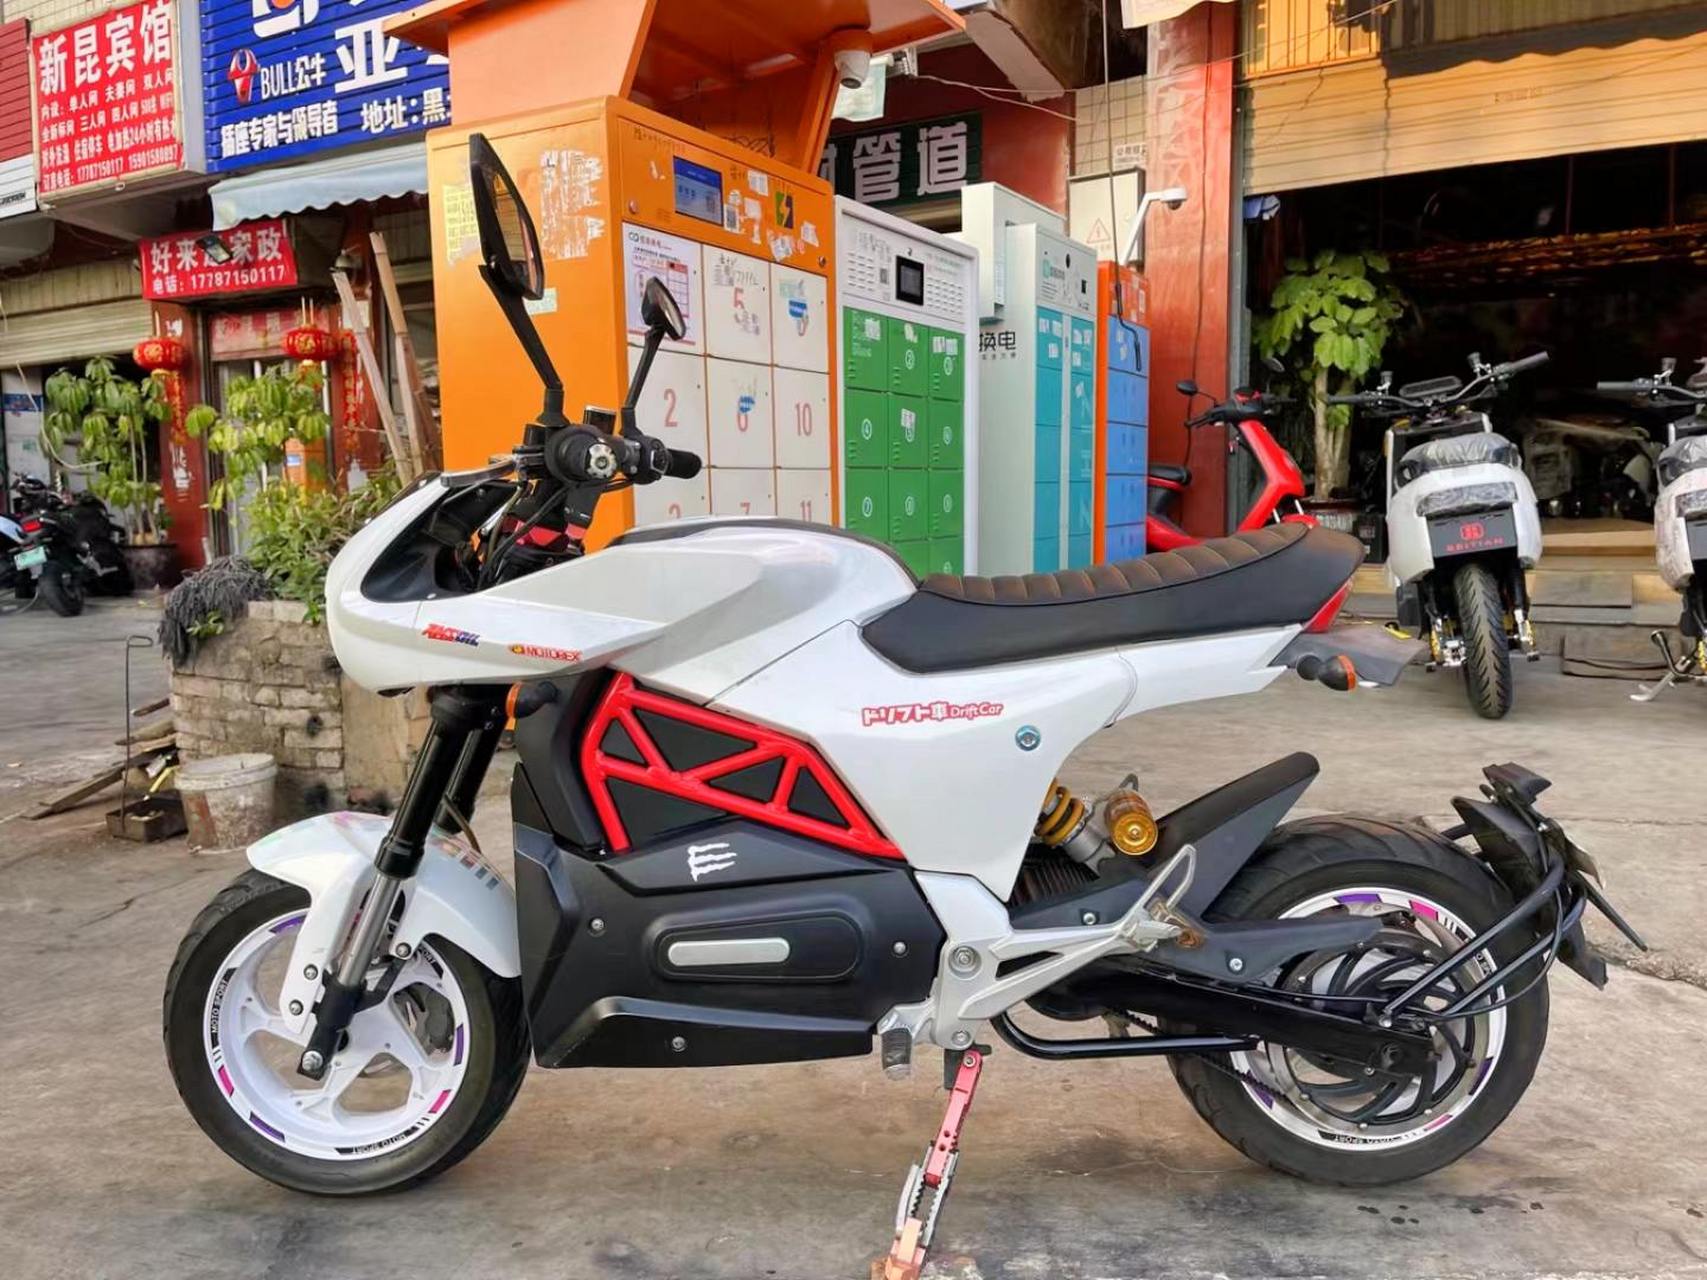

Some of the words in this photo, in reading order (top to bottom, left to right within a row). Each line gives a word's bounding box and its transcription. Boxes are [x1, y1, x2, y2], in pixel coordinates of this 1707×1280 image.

[39, 2, 172, 95] 新昆宾馆
[261, 61, 296, 100] BULL
[191, 264, 285, 289] 17787150117
[664, 387, 678, 428] 2
[796, 401, 812, 437] 10
[862, 702, 950, 726] ドリフト車
[211, 1007, 220, 1034] MOTO
